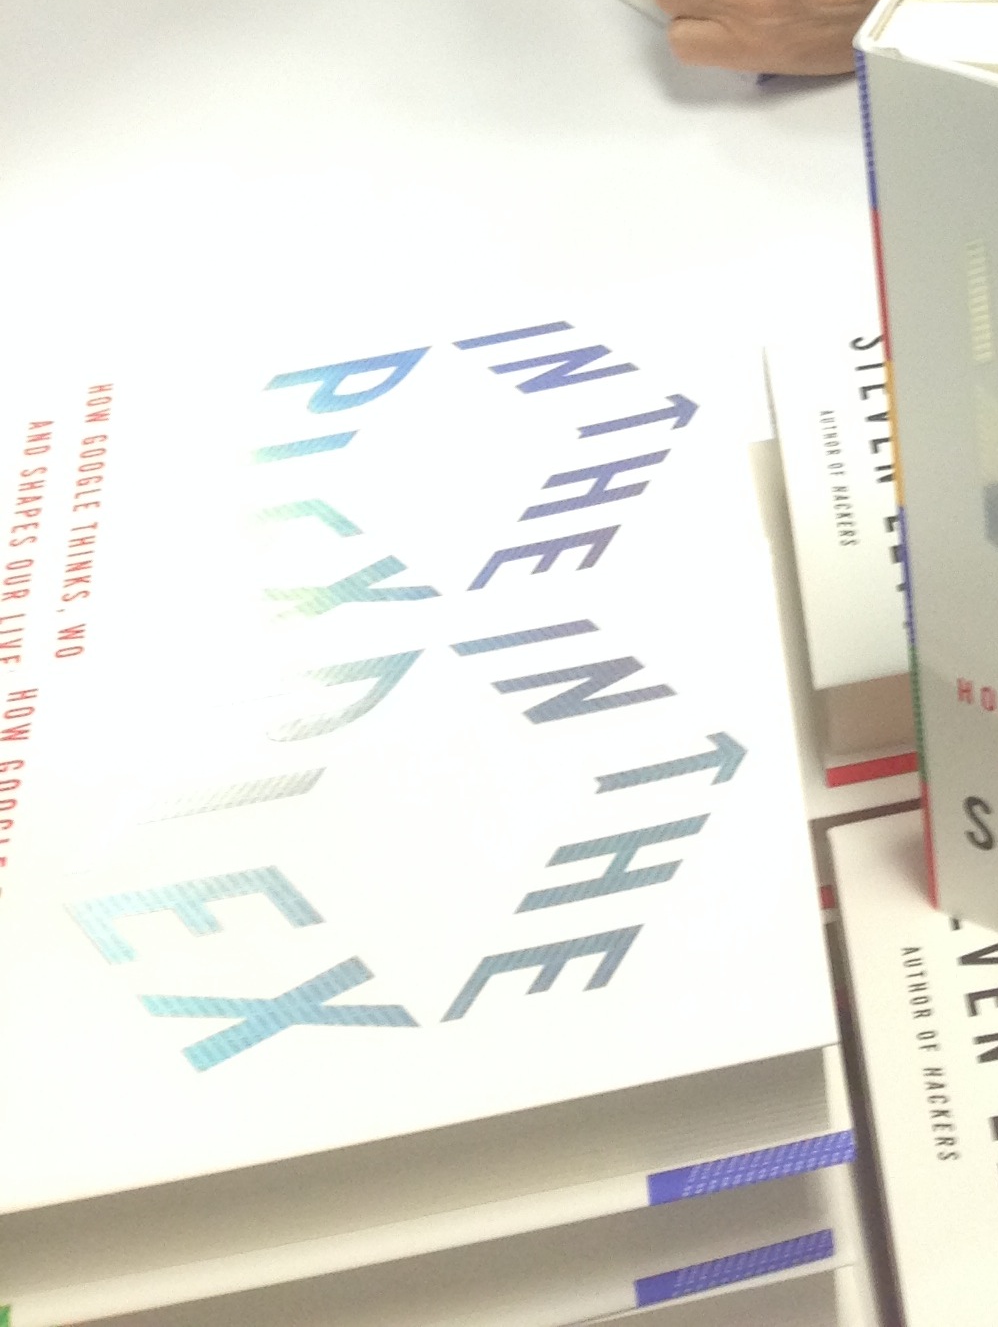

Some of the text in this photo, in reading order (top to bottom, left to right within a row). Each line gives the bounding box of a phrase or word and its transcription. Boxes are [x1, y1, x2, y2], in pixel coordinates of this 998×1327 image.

[23, 419, 55, 457] AND
[84, 383, 114, 424] HOW
[71, 433, 108, 513] GOOGLE
[451, 320, 700, 592] IN THE
[819, 410, 859, 548] AUTHOR OF HACKERS
[8, 466, 49, 550] SHAPES
[1, 558, 35, 601] OUR
[440, 618, 748, 1024] IN THE
[901, 946, 960, 1163] AUTHOR OF HACKERS
